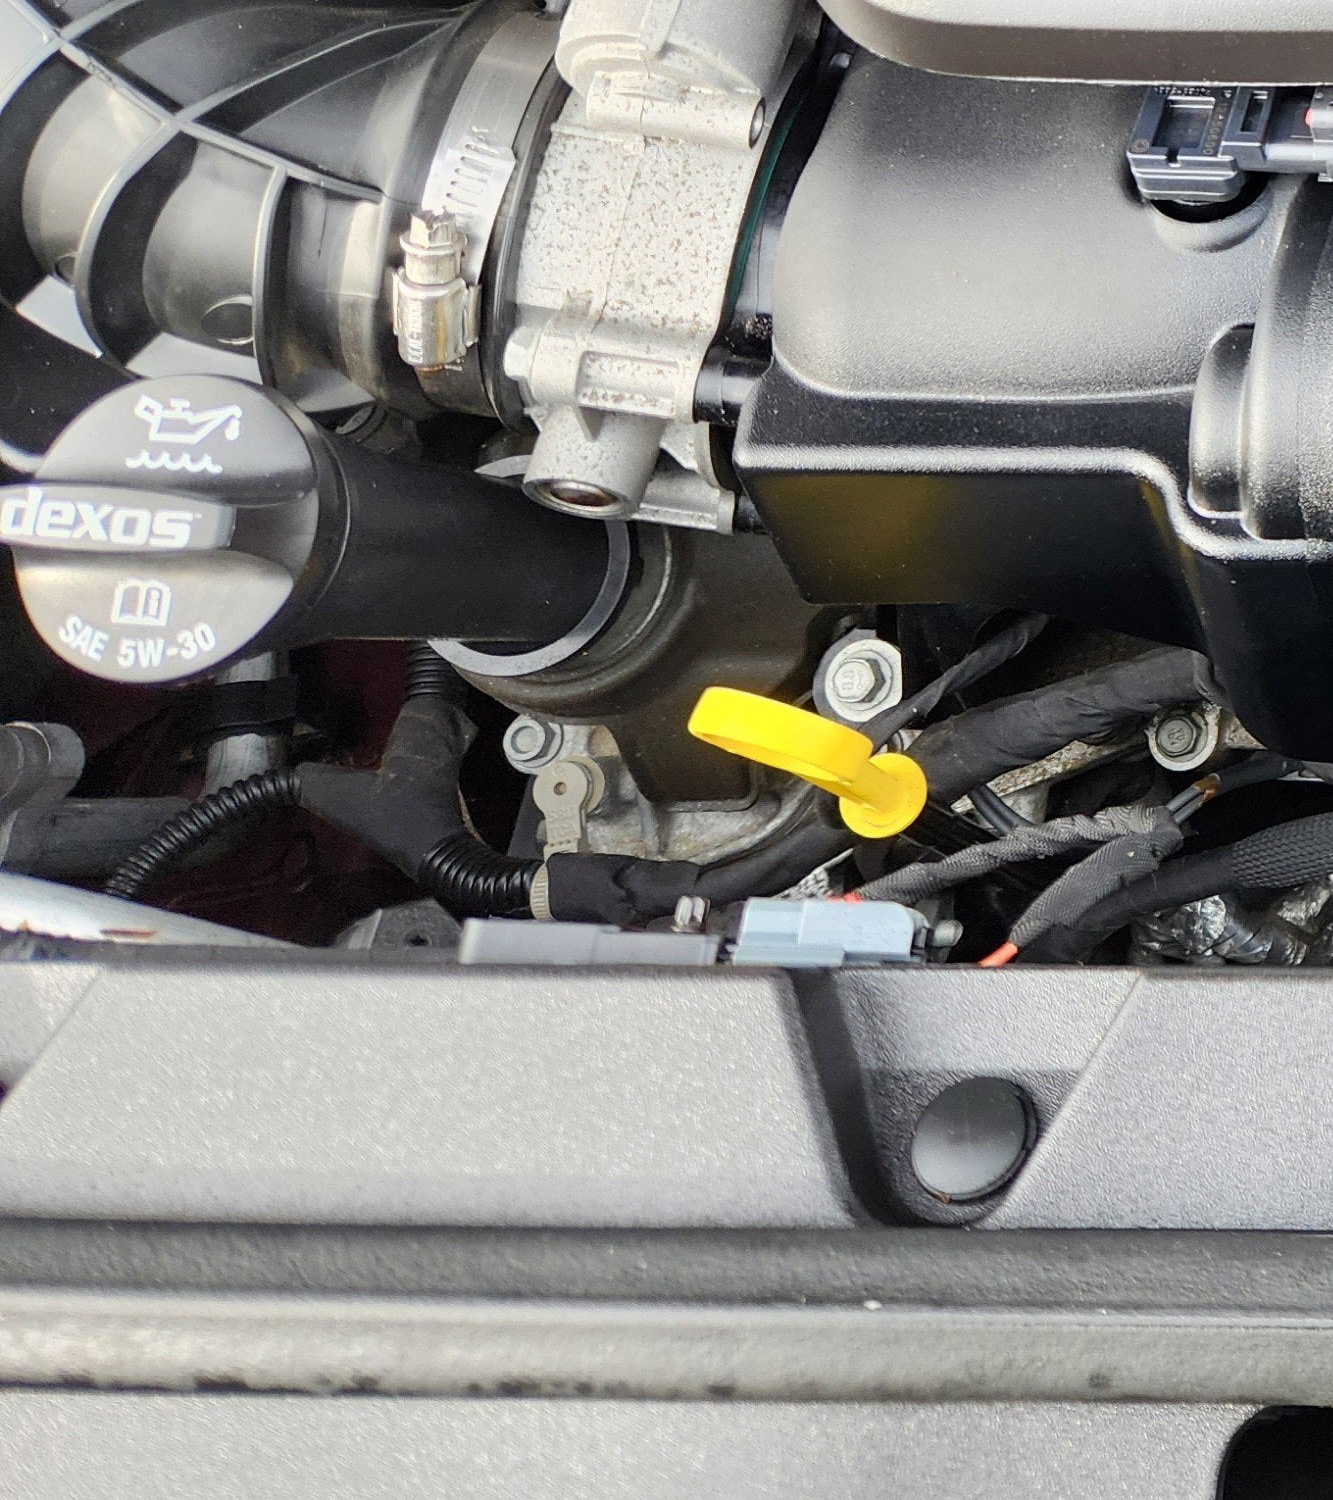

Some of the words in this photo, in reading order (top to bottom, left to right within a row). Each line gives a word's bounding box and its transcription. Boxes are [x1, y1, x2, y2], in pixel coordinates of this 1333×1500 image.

[0, 484, 194, 549] dexos
[58, 614, 110, 661] SAE
[116, 621, 217, 669] 5W-30
